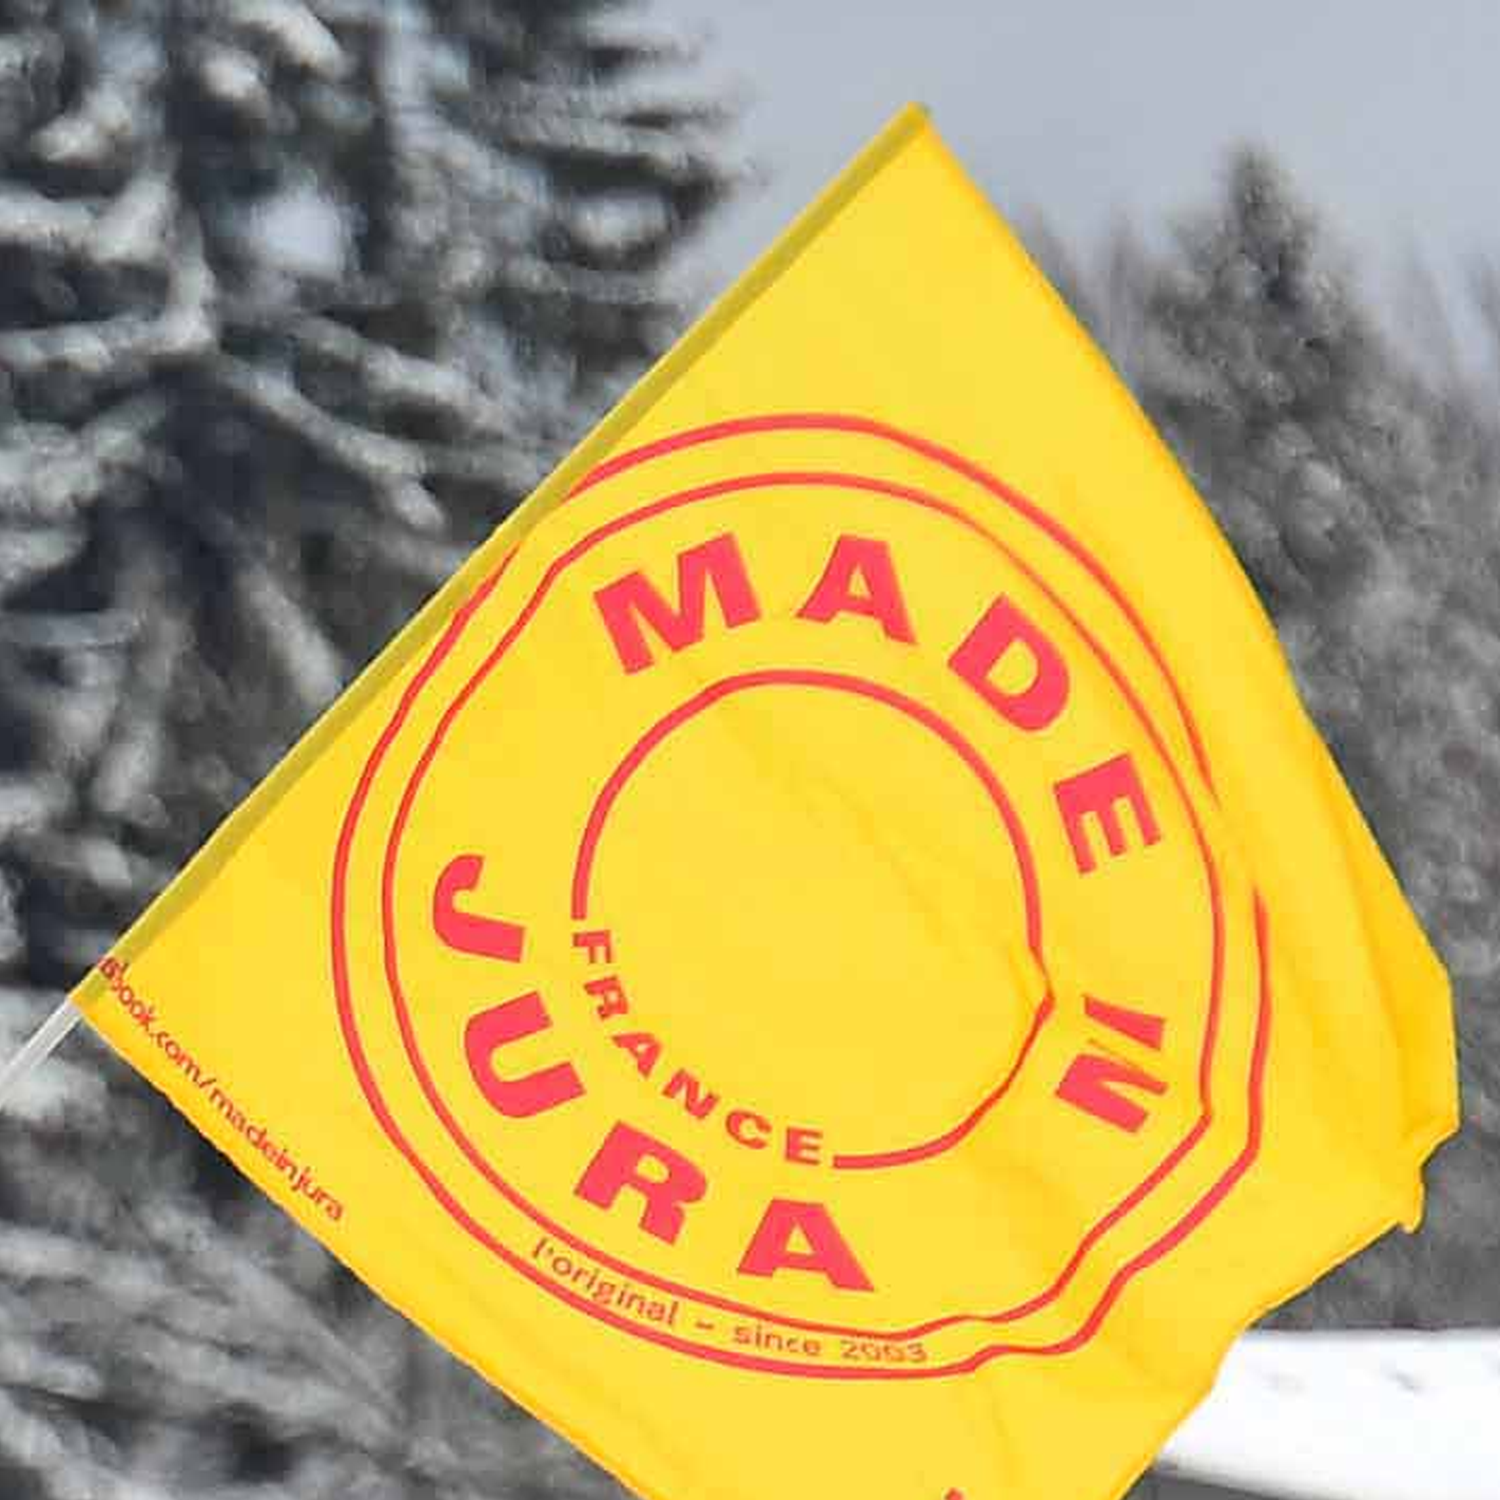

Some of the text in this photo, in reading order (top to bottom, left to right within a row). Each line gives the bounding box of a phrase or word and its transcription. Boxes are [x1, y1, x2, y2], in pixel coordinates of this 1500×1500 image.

[433, 533, 1168, 1292] MADE IN JURA
[572, 929, 823, 1167] FRANCE
[531, 1238, 680, 1327] l'original
[733, 1323, 822, 1358] since
